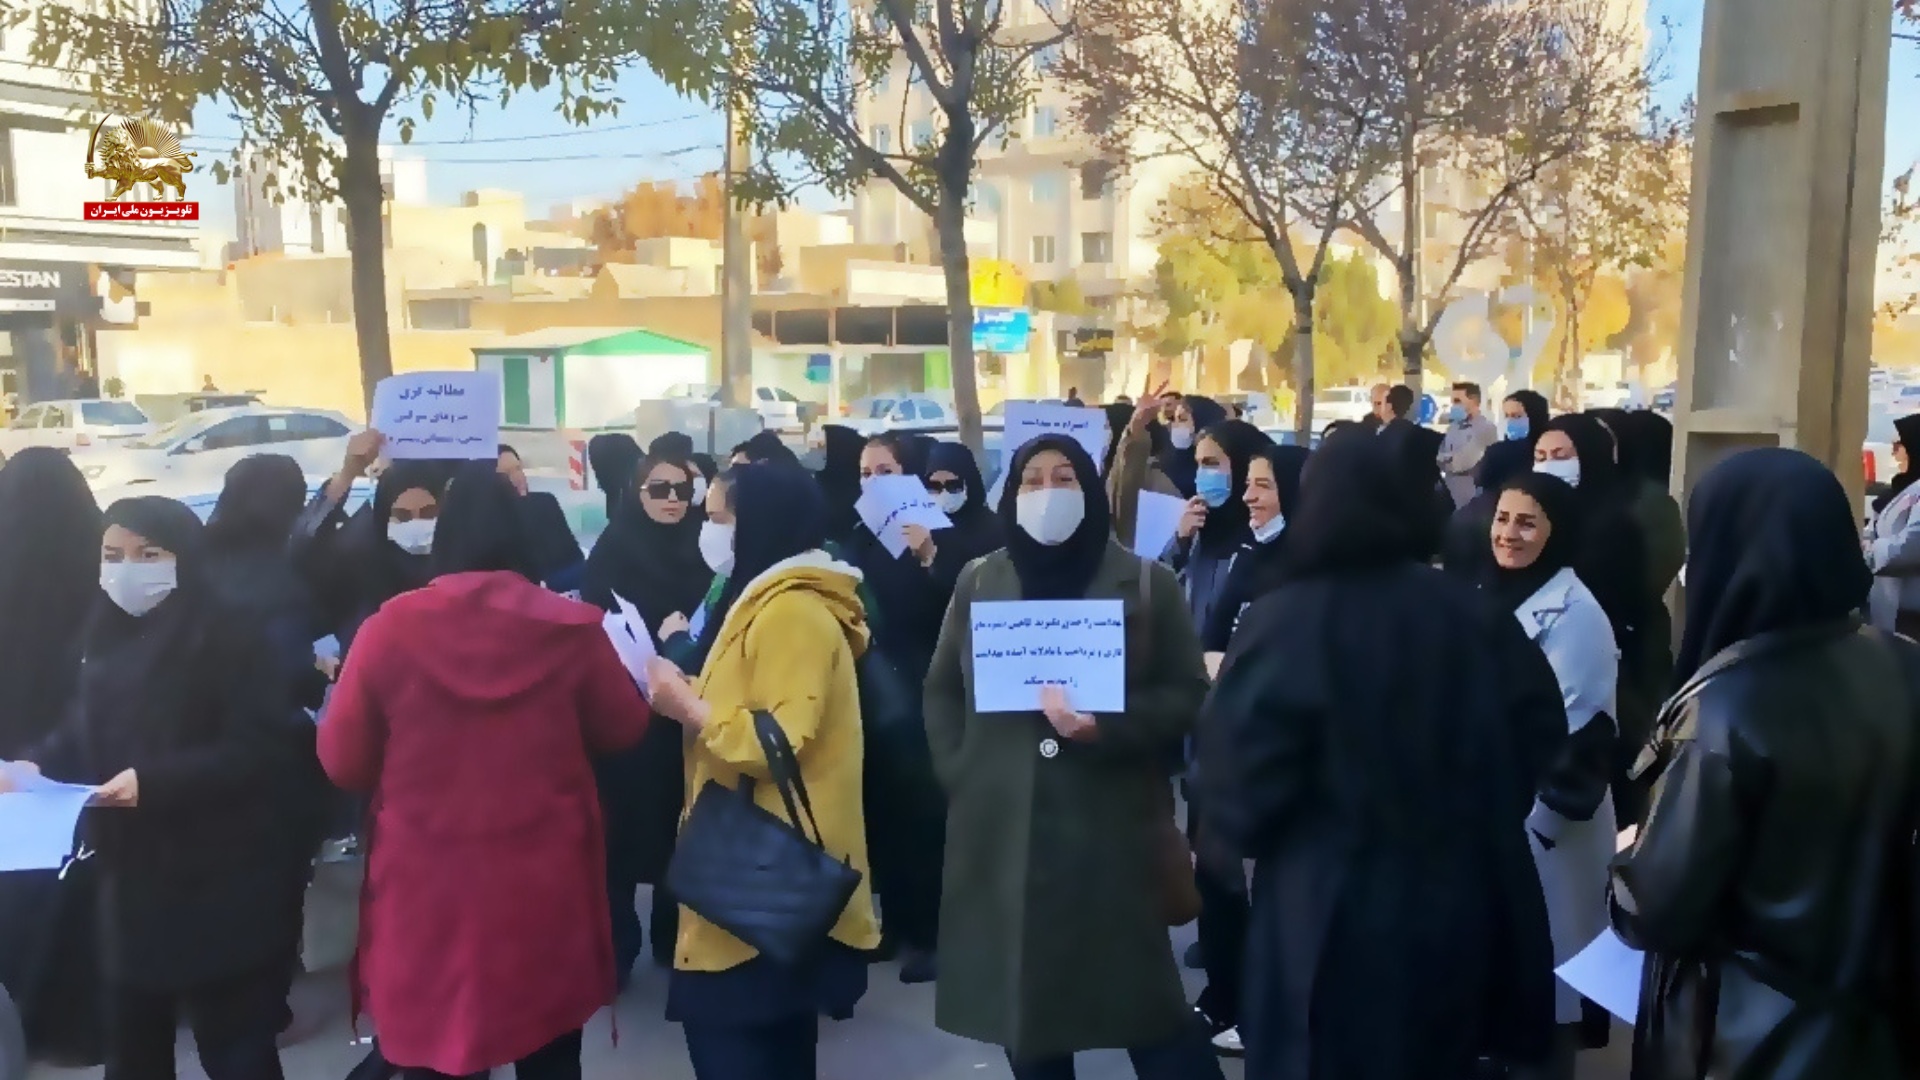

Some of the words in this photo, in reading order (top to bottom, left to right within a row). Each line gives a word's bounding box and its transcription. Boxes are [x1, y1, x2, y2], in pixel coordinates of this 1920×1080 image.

[426, 383, 465, 401] مطالبه
[1084, 618, 1093, 629] را
[1093, 618, 1122, 628] بهداشت
[975, 648, 1003, 658] بهداشت
[1006, 646, 1027, 659] آینده
[1064, 646, 1095, 659] پرداخت
[1069, 676, 1079, 688] را
